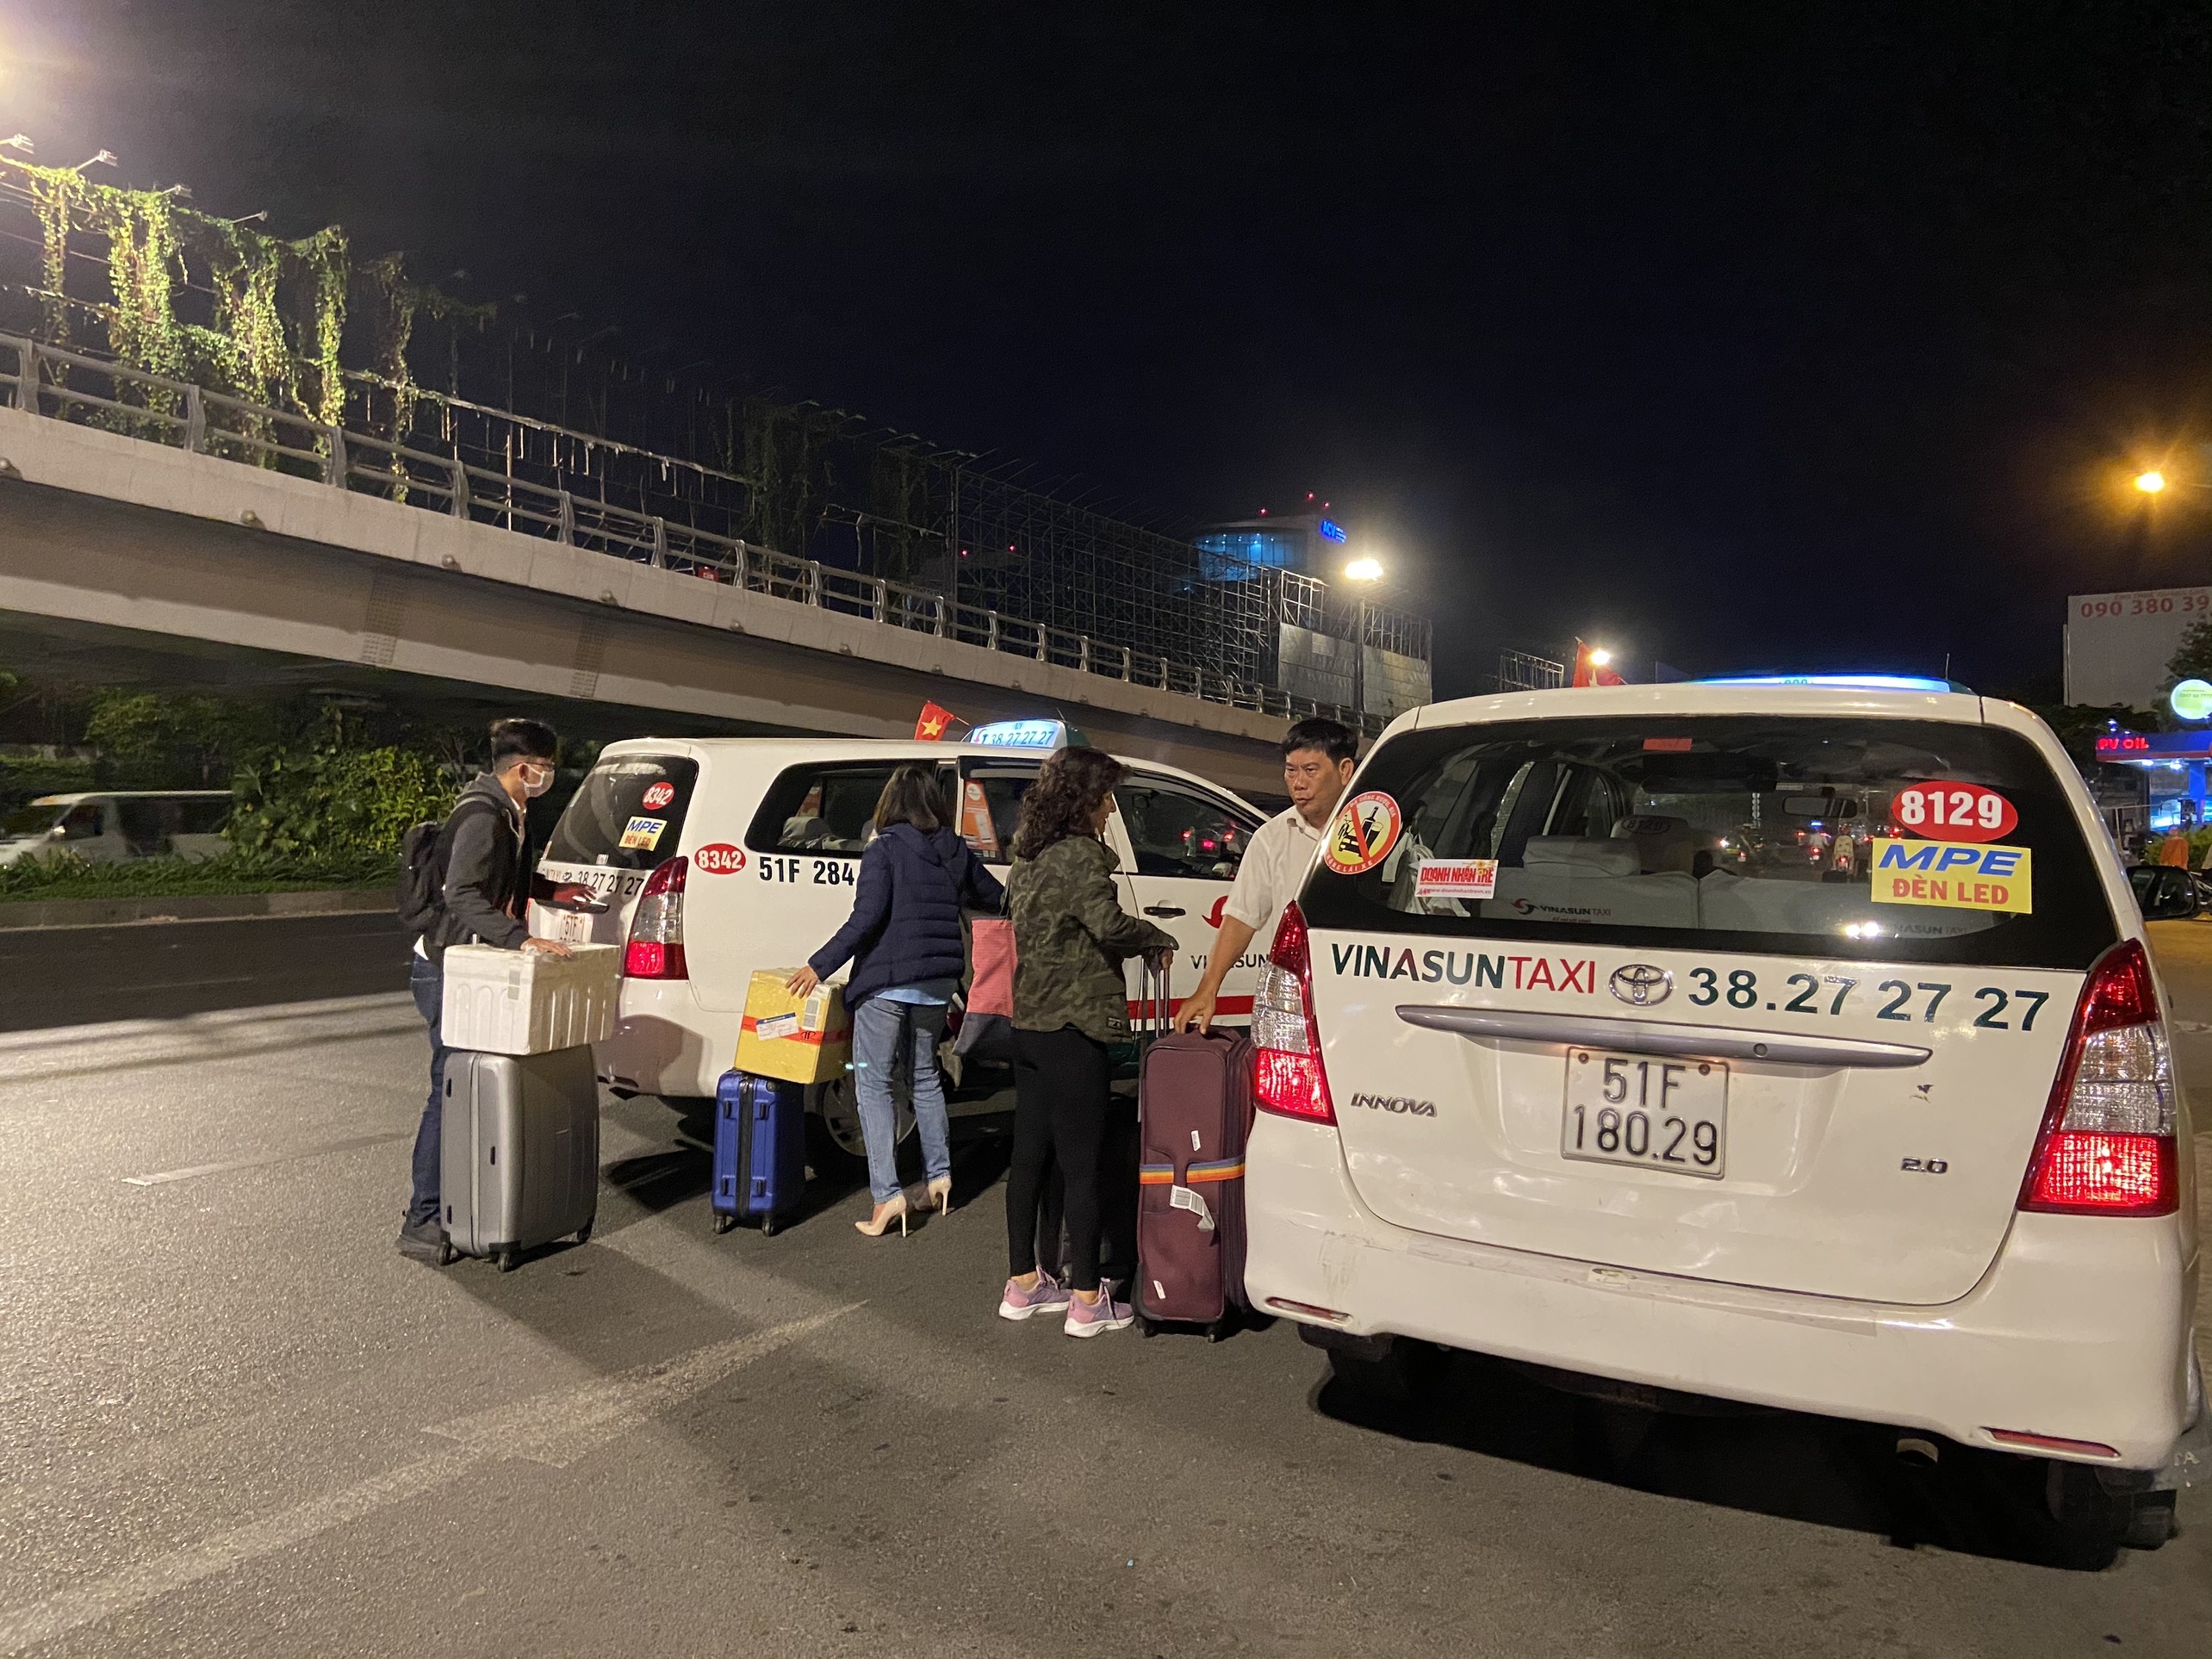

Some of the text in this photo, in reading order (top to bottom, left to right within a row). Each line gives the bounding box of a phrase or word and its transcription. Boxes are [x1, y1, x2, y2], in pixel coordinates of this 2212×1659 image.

[2081, 602, 2122, 618] 090
[2131, 598, 2173, 615] 380
[2098, 737, 2149, 749] PV OIL
[643, 787, 673, 805] 8342
[1901, 790, 2003, 829] 8129
[627, 820, 662, 834] MPE
[638, 836, 651, 847] LED
[698, 850, 743, 869] 8342
[1878, 844, 2022, 877] MPE
[759, 856, 854, 886] 51F 284
[1420, 867, 1450, 882] DOANH
[606, 875, 623, 894] 27
[624, 877, 644, 896] 27
[1892, 874, 2009, 905] ĐÈN LED
[1876, 979, 1952, 1023] 27
[1973, 987, 2050, 1032] 27
[1604, 1058, 1686, 1109] 51F
[1351, 1092, 1437, 1117] INNOVA
[1575, 1104, 1718, 1165] 180.29
[1901, 1158, 1948, 1174] 2.0
